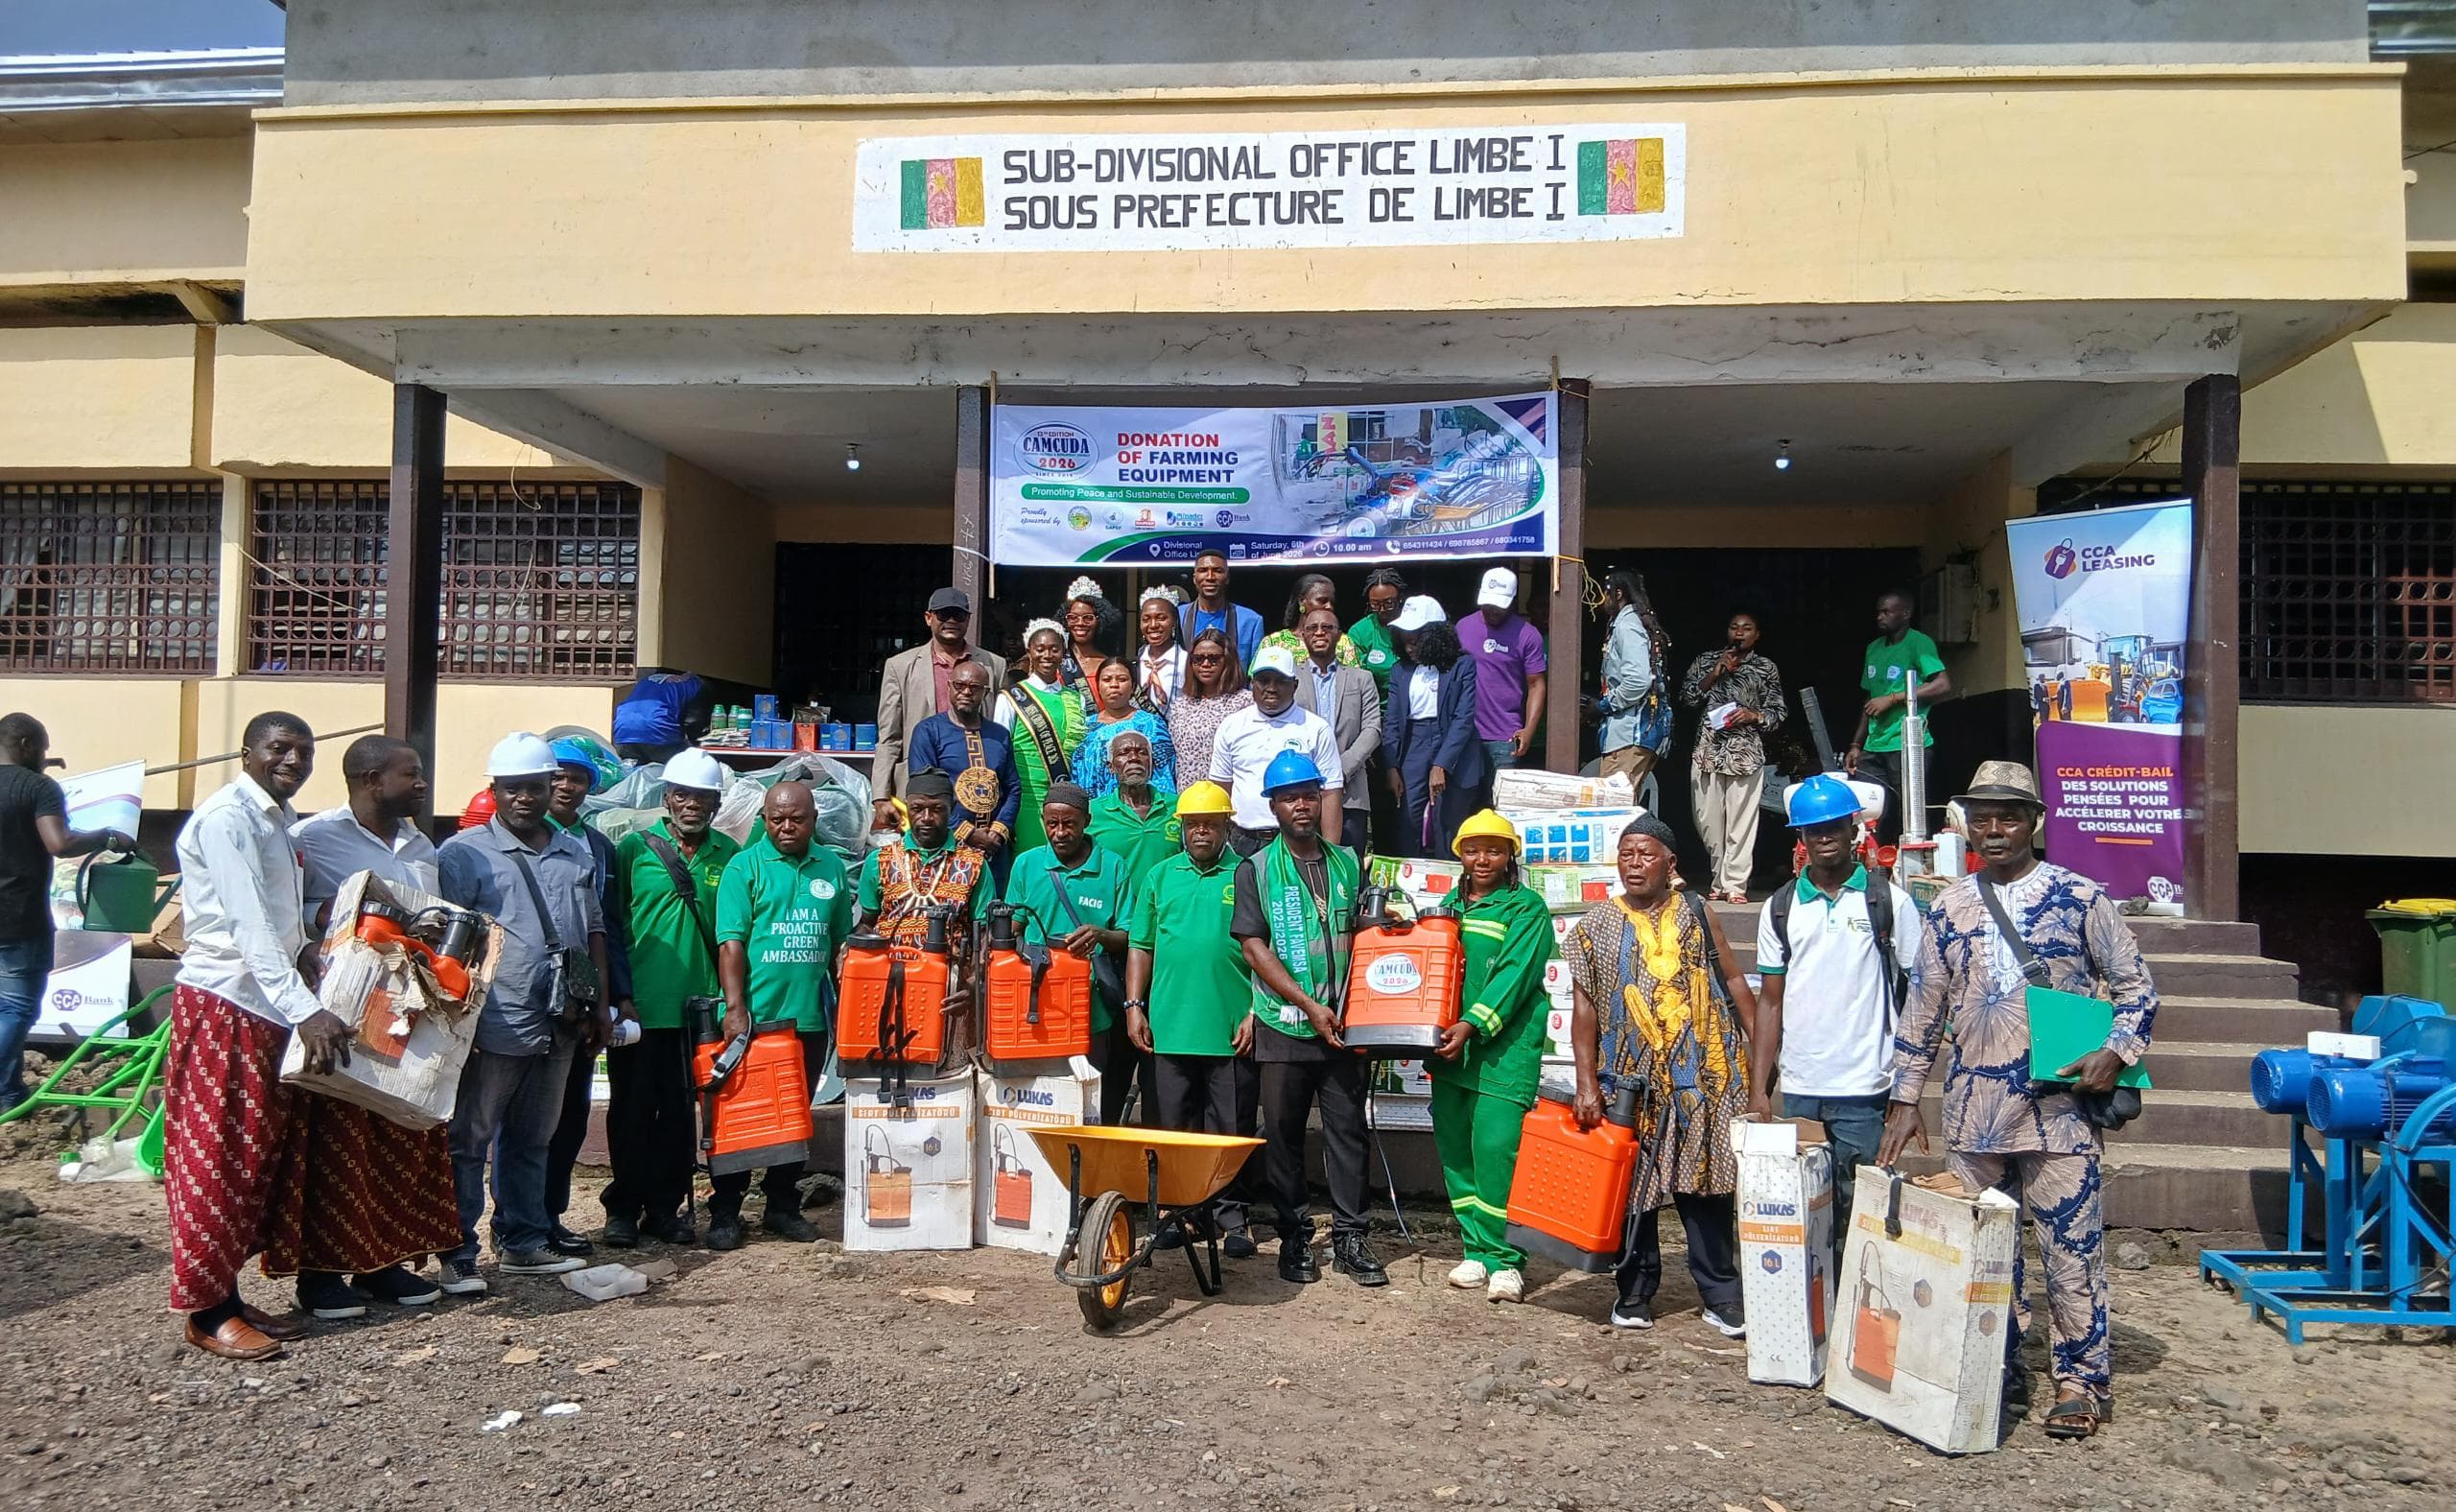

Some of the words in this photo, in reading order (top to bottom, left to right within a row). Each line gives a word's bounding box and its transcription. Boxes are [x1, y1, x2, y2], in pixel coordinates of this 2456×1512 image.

[1004, 145, 1276, 184] SUB-DIVISIONAL
[1289, 140, 1416, 177] OFFICE
[1429, 135, 1533, 175] LIMBE
[1547, 134, 1567, 171] I
[1004, 195, 1098, 230] SOUS
[1114, 189, 1344, 229] PREFECTURE
[1369, 187, 1415, 223] DE
[1434, 186, 1534, 221] LIMBE
[1545, 182, 1567, 221] I
[1023, 437, 1090, 454] CAMCUDA
[1117, 433, 1219, 447] DONATION
[1039, 458, 1076, 468] 2026
[1118, 451, 1142, 464] OF
[1149, 451, 1239, 465] FARMING
[1119, 468, 1235, 483] EQUIPMENT
[1031, 486, 1074, 498] Promoting
[1076, 487, 1104, 497] Peace
[1107, 489, 1123, 498] and
[1125, 489, 1175, 499] Sustainable
[1178, 490, 1238, 501] Development.
[1021, 508, 1048, 516] Proudly
[1021, 516, 1051, 525] sponsored
[1052, 516, 1061, 526] by
[1163, 540, 1203, 550] Divisional
[1251, 541, 1289, 551] Saturday,
[1334, 543, 1357, 553] 10.00
[2081, 545, 2116, 559] CCA
[1164, 550, 1188, 558] Office
[1251, 551, 1260, 559] of
[1283, 550, 1304, 558] 2026
[2082, 555, 2156, 573] LEASING
[2056, 767, 2084, 778] CCA
[2087, 765, 2174, 778] CRÉDIT-BAIL
[2061, 780, 2088, 791] DES
[2090, 780, 2168, 791] SOLUTIONS
[2063, 792, 2122, 805] PENSÉES
[2128, 794, 2169, 806] POUR
[2055, 806, 2131, 818] ACCÉLERER
[2134, 808, 2183, 820] VOTRE
[2077, 821, 2164, 834] CROISSANCE
[2149, 882, 2173, 899] CCA
[1078, 896, 1103, 910] FACIG
[1284, 886, 1304, 933] PRESIDENT
[786, 909, 790, 921] I
[791, 908, 809, 921] AM
[811, 908, 819, 921] A
[770, 921, 829, 935] PROACTIVE
[1272, 900, 1287, 960] 2025/2026
[783, 935, 819, 949] GREEN
[53, 993, 81, 1008] CCA
[84, 995, 115, 1005] Bank
[1017, 1089, 1053, 1105] LUKAS
[1757, 1203, 1796, 1217] LUKAS
